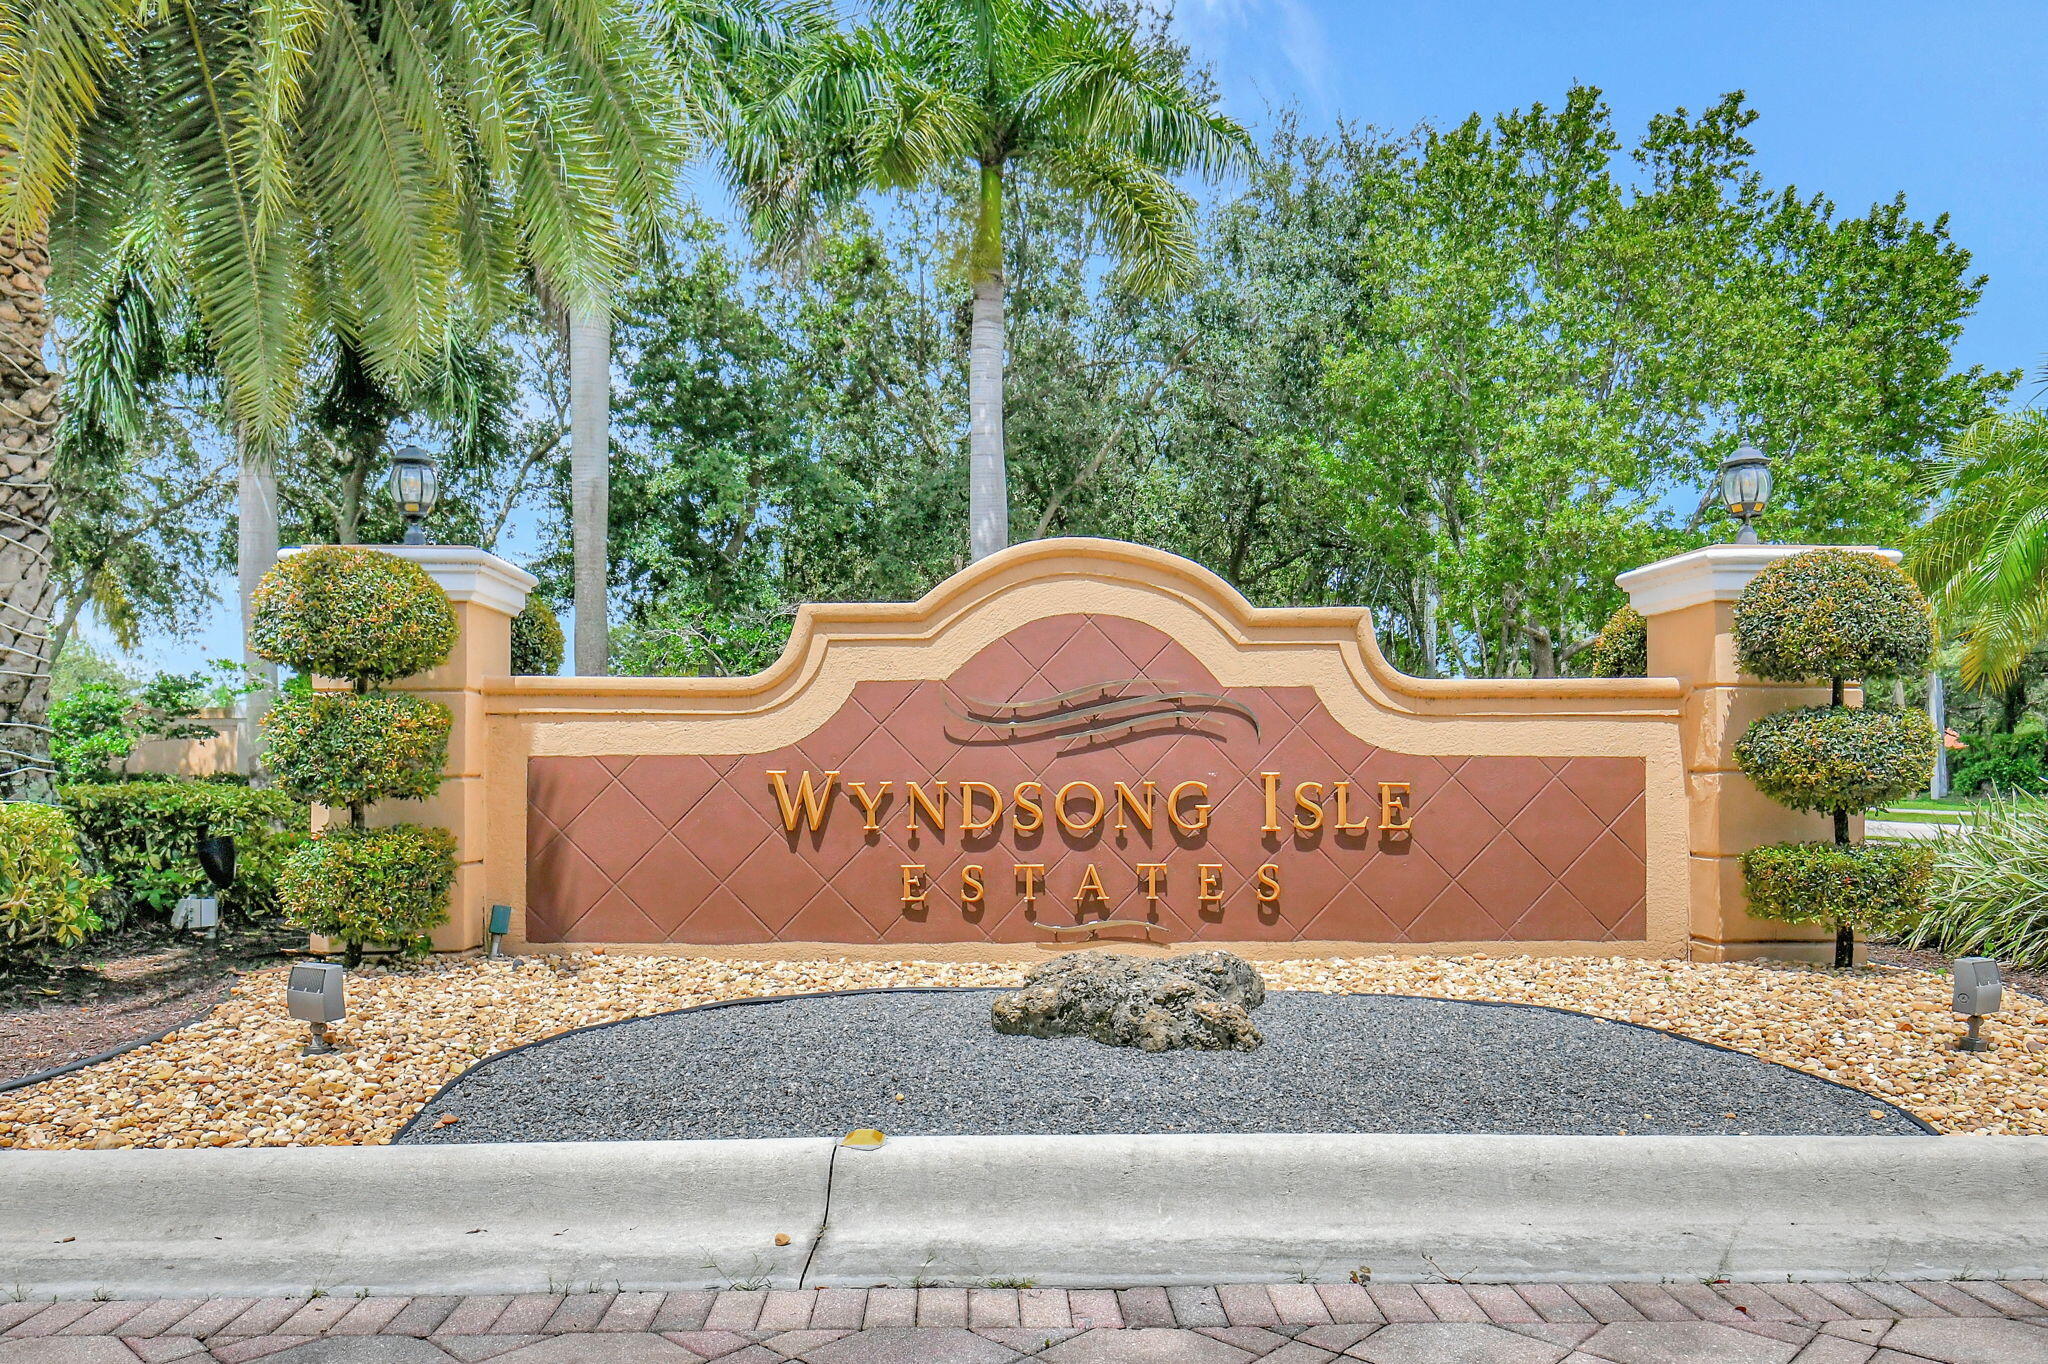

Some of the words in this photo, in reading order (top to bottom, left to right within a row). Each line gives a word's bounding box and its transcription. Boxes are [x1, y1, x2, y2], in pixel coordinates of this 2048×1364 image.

[765, 769, 1212, 832] WYNDSONG
[1260, 771, 1413, 832] ISLE
[900, 863, 1281, 903] ESTATES
